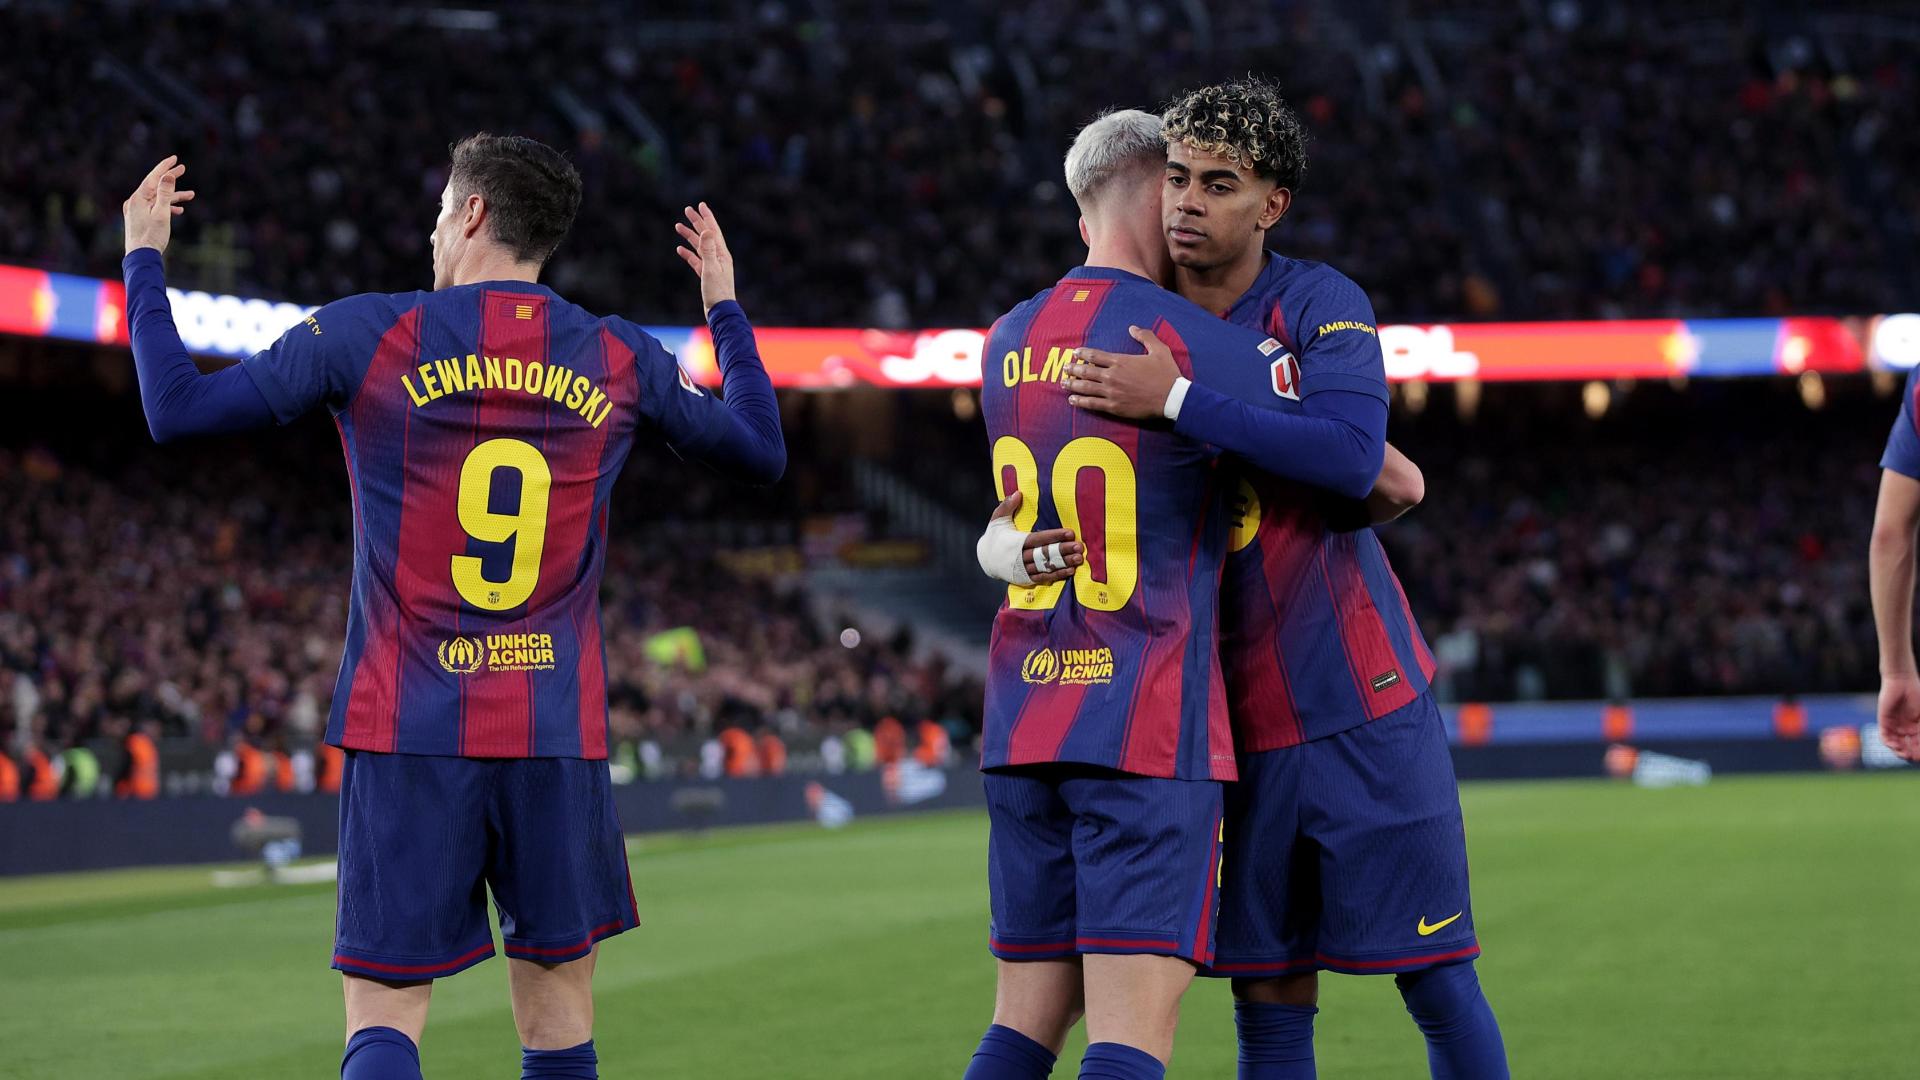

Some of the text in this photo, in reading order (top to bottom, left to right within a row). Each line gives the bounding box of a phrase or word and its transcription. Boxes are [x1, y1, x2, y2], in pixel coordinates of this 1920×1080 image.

[1003, 346, 1085, 388] OLM
[400, 354, 614, 429] LEWANDOWSKI
[451, 438, 551, 611] 9
[487, 634, 552, 650] UNHCR
[488, 649, 555, 665] ACNUR
[1062, 648, 1113, 665] UNHCR
[1060, 663, 1113, 680] ACNUR
